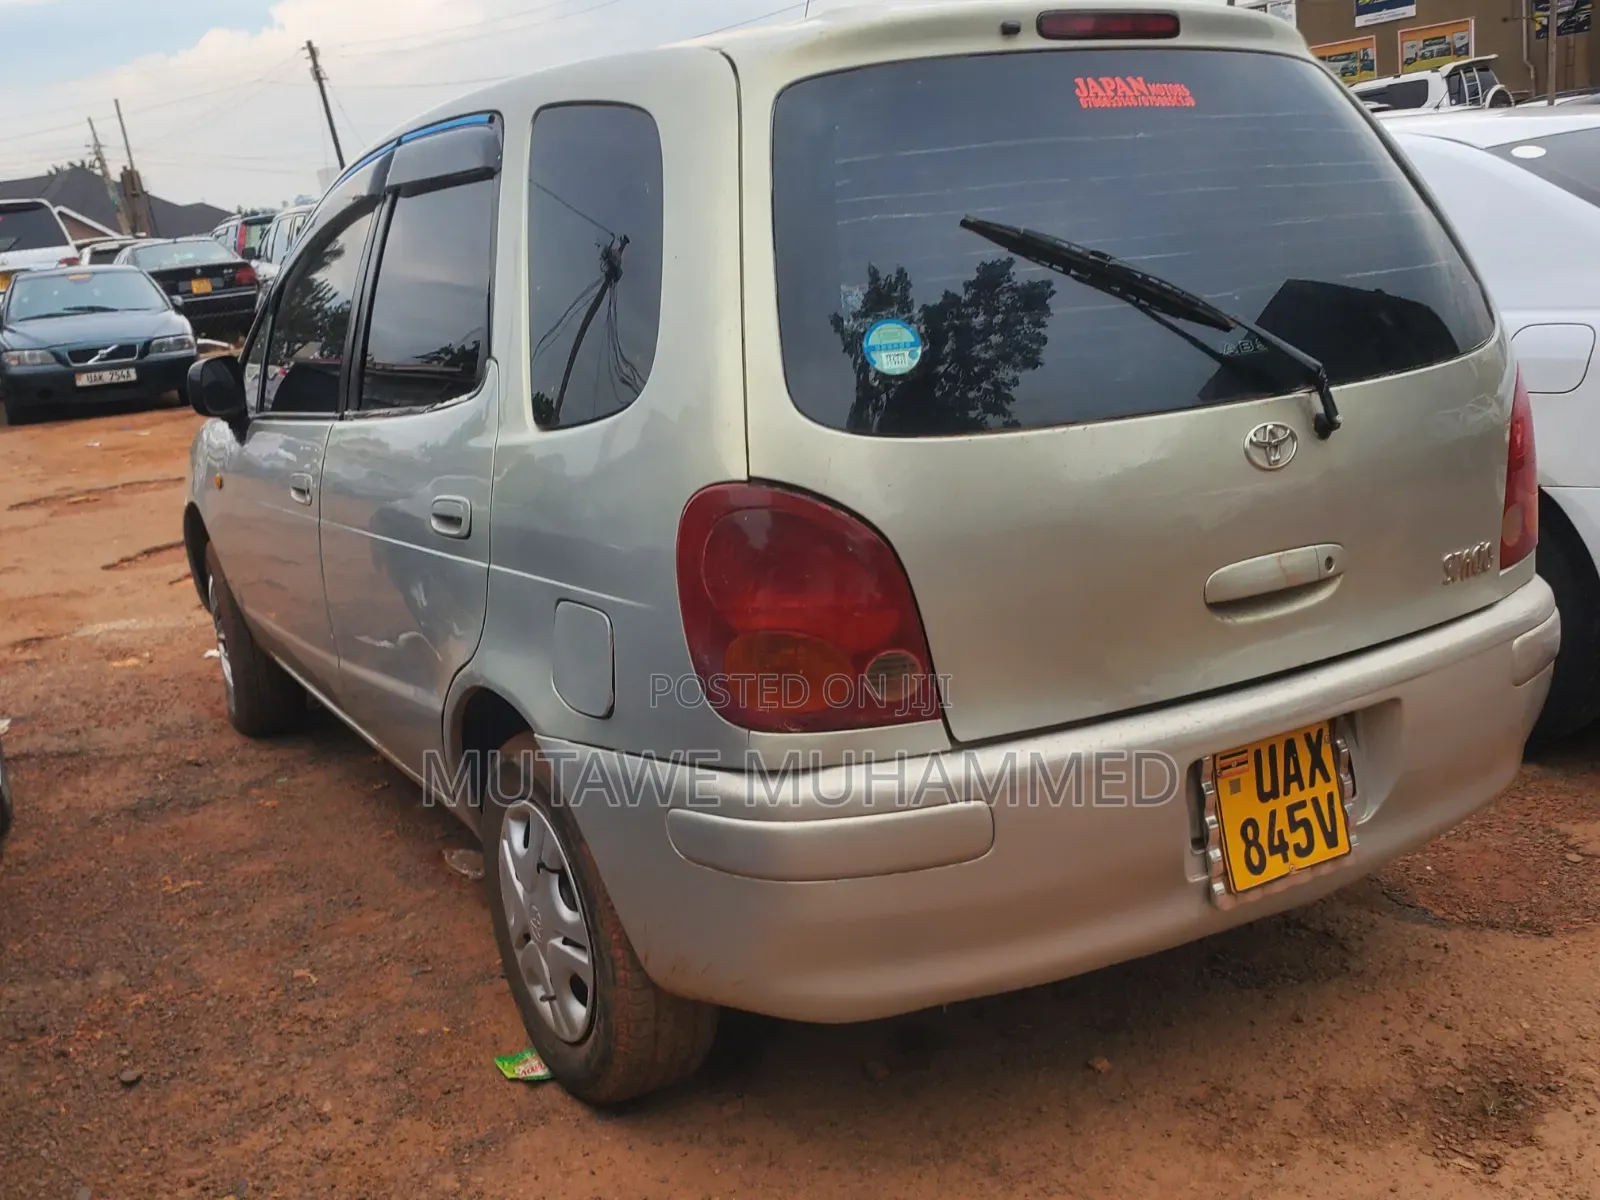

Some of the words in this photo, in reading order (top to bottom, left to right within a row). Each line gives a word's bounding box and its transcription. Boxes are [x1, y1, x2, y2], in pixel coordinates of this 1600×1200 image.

[1074, 76, 1149, 97] JAPAN
[1253, 728, 1332, 804] UAX
[1239, 791, 1339, 876] 845V
